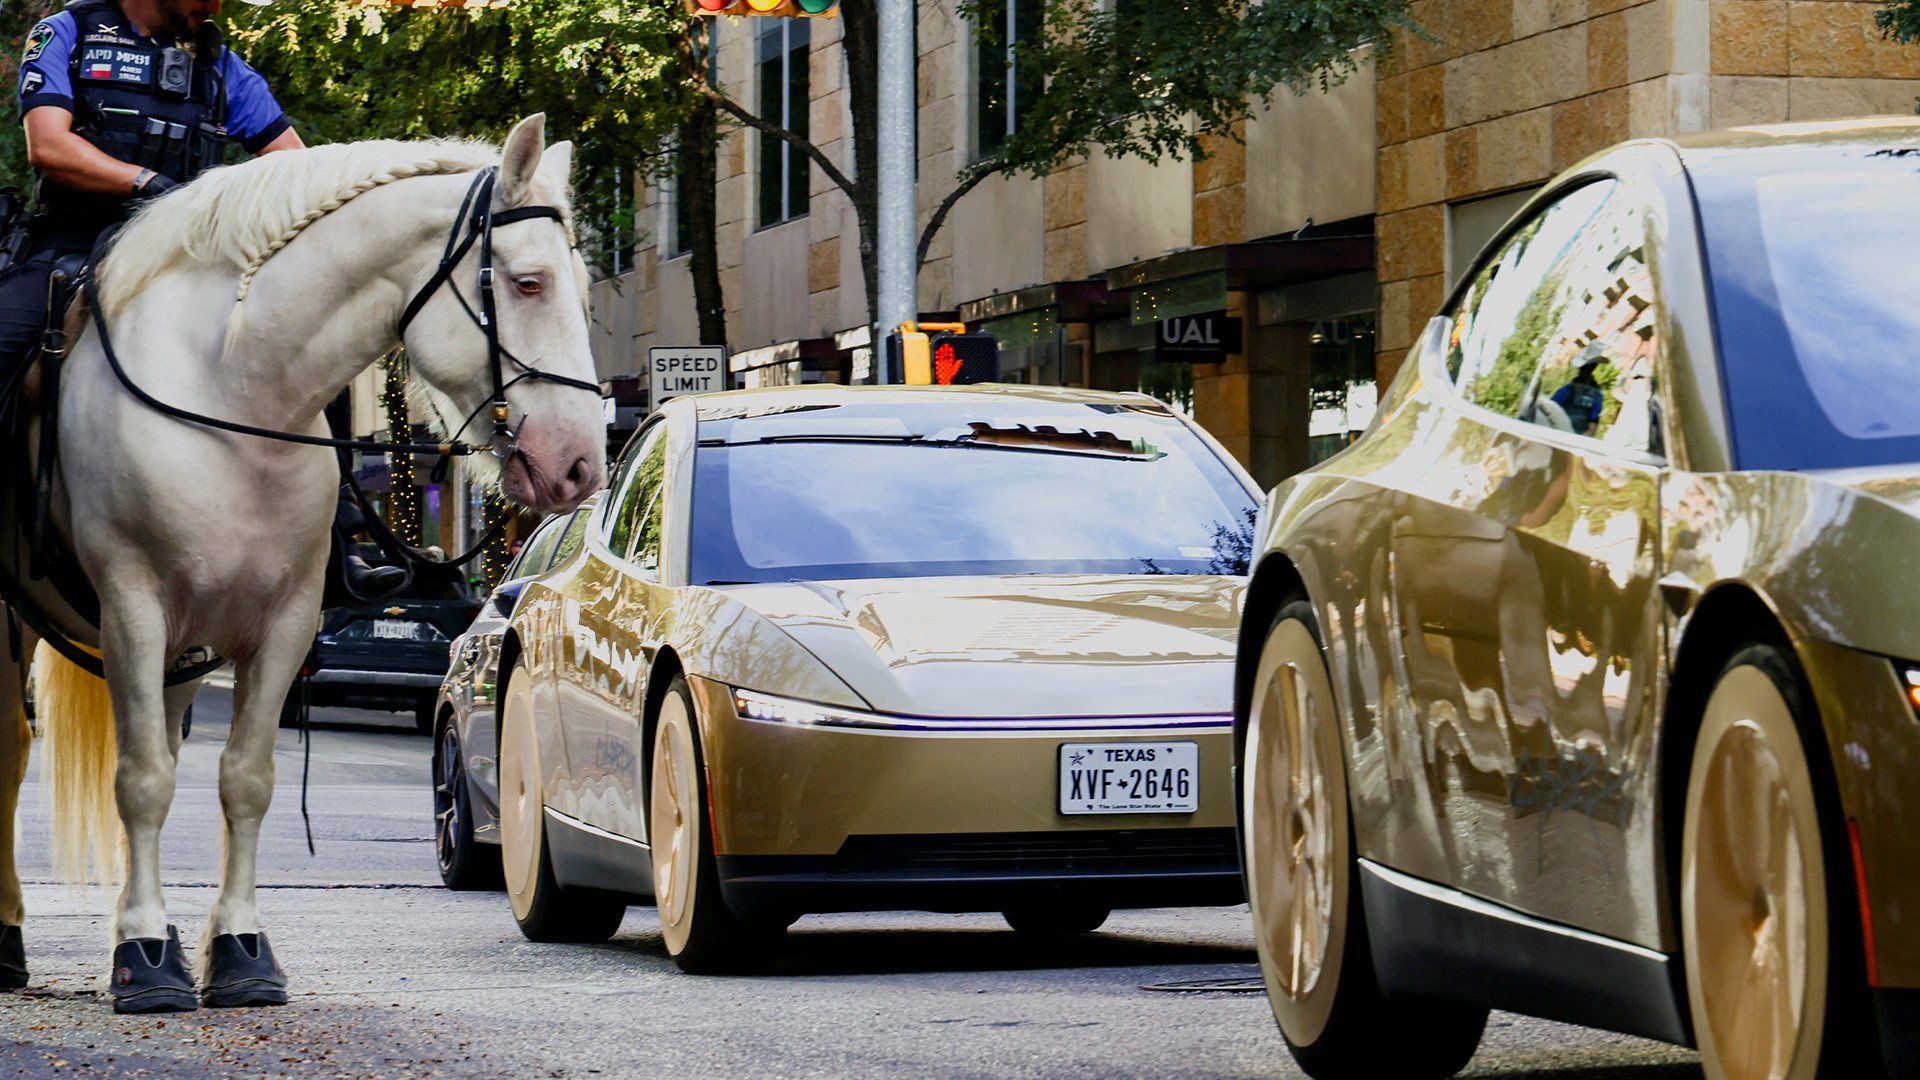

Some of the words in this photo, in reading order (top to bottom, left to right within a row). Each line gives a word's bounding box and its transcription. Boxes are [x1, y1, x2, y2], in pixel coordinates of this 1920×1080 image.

[85, 49, 112, 60] APD
[1162, 318, 1220, 344] UAL
[656, 358, 718, 372] SPEED
[663, 377, 711, 391] LIMIT
[1104, 749, 1156, 762] TEXAS
